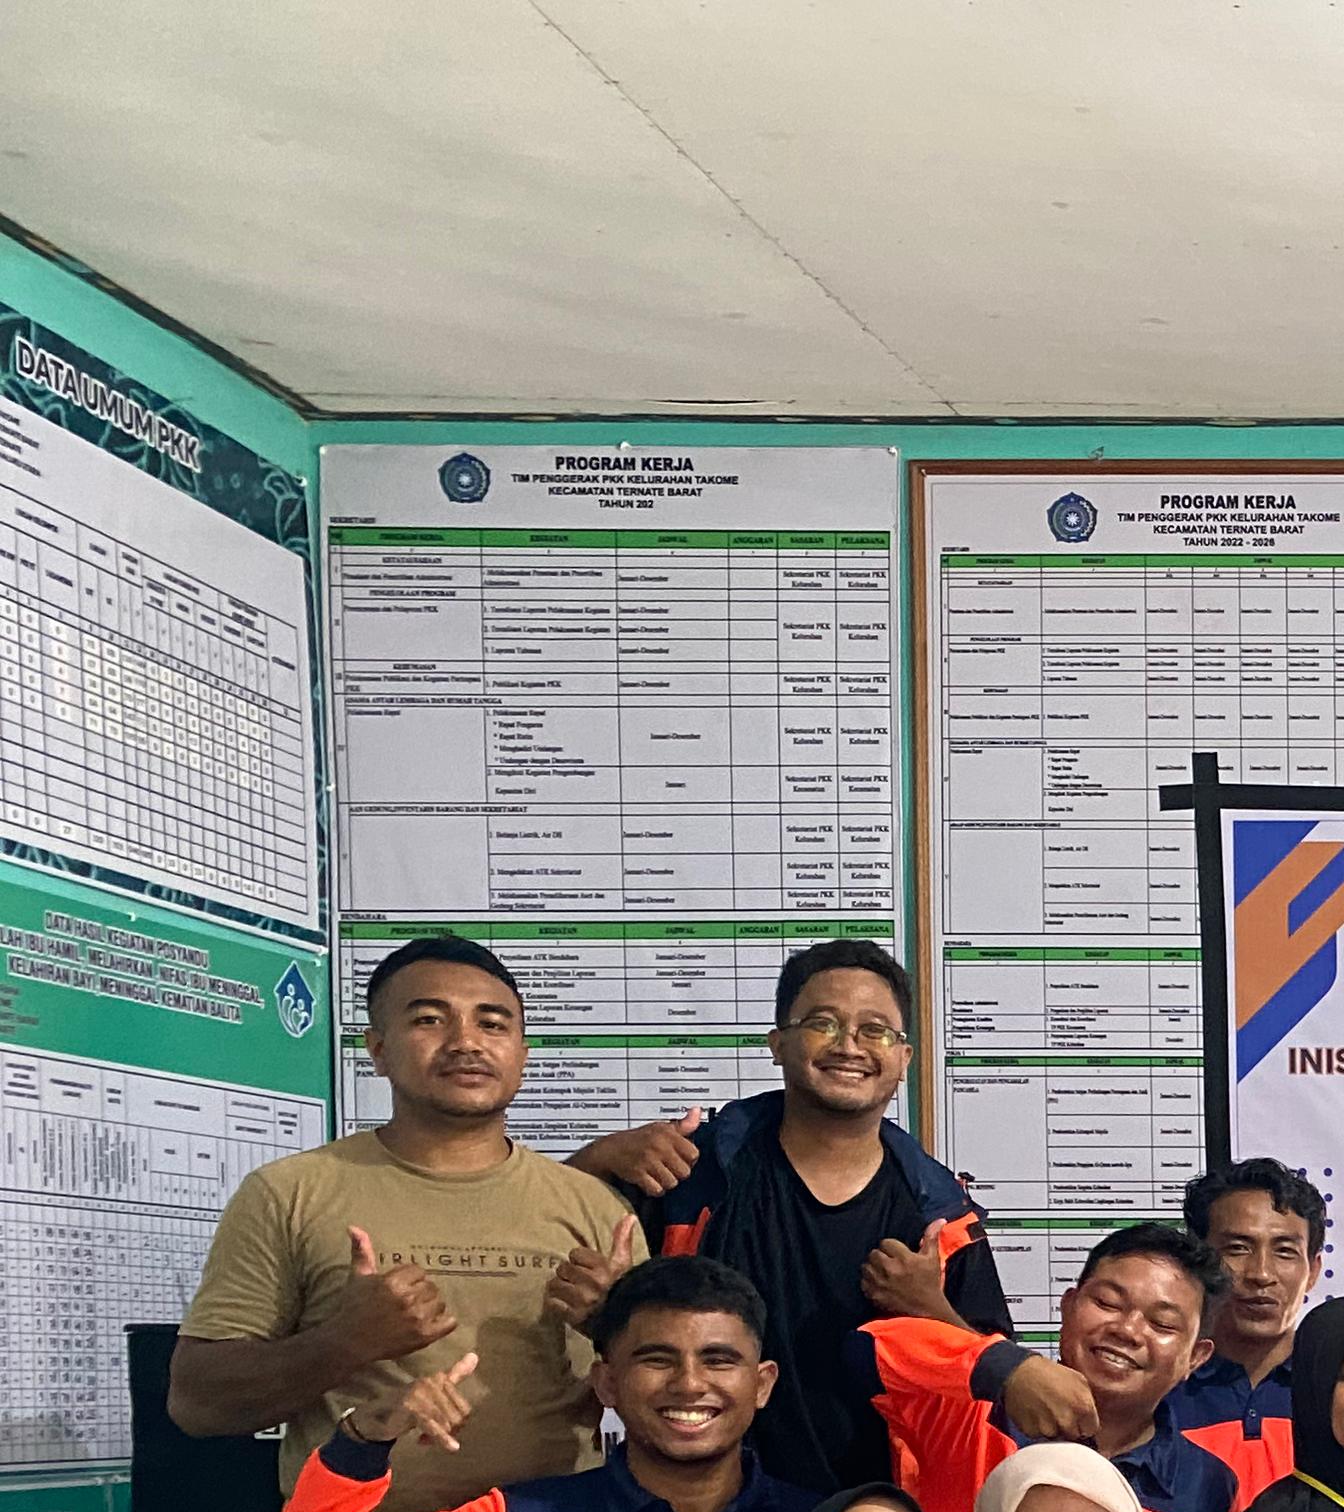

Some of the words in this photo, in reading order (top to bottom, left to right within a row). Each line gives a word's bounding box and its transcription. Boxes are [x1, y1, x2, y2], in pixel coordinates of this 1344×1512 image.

[16, 337, 79, 404] DATA
[82, 373, 154, 445] UMUM
[156, 418, 200, 471] PKK
[555, 456, 636, 471] PROGRAM
[641, 457, 694, 471] KERJA
[511, 474, 530, 483] TIM
[532, 474, 600, 484] PENGGERAK
[602, 475, 624, 484] PKK
[627, 475, 692, 485] KELURAHAN
[696, 476, 739, 485] TAKOME
[548, 487, 613, 496] KECAMATAN
[617, 487, 665, 496] TERNATE
[667, 488, 703, 497] BARAT
[599, 499, 634, 508] TAHUN
[1160, 495, 1239, 509] PROGRAM
[1244, 495, 1296, 509] KERJA
[1117, 513, 1135, 522] TIM
[1138, 513, 1204, 522] PENGGERAK
[1206, 513, 1227, 522] PKK
[1230, 513, 1294, 522] KELURAHAN
[1297, 514, 1340, 522] TAKOME
[1153, 525, 1217, 534] KECAMATAN
[1219, 525, 1267, 534] TERNATE
[1270, 525, 1305, 534] BARAT
[1183, 537, 1218, 546] TAHUN
[1220, 537, 1244, 546] 2022
